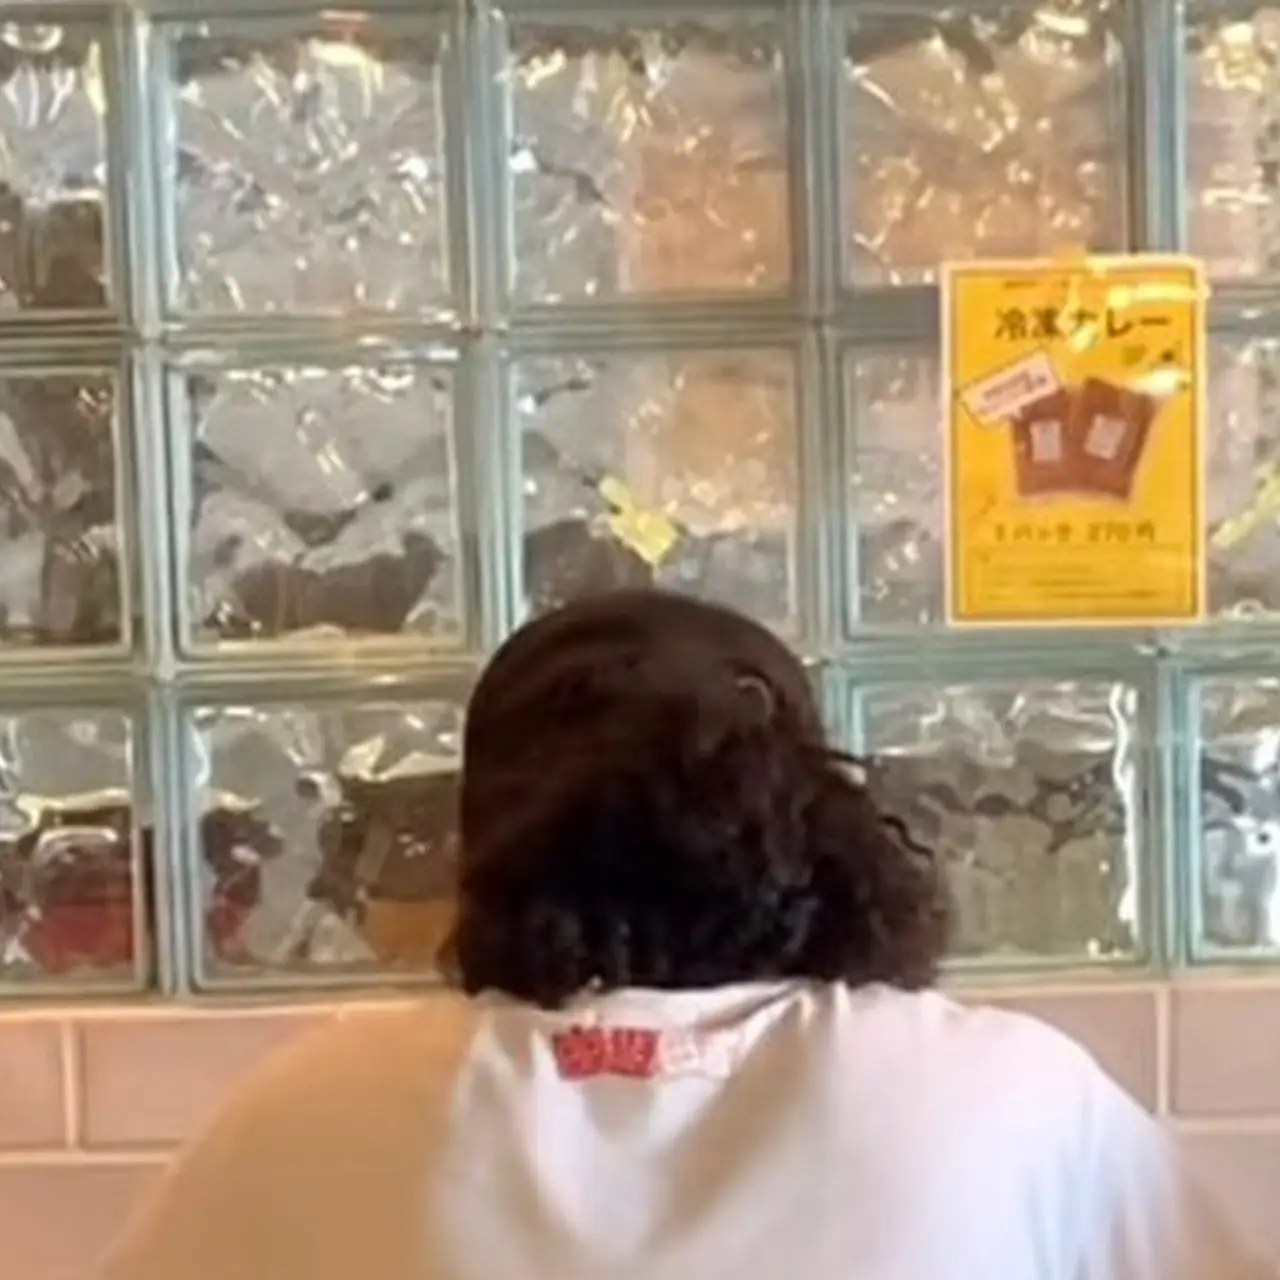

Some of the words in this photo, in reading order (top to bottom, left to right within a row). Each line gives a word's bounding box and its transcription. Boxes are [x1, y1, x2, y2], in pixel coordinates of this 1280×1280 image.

[993, 304, 1172, 342] 冷凍カレー
